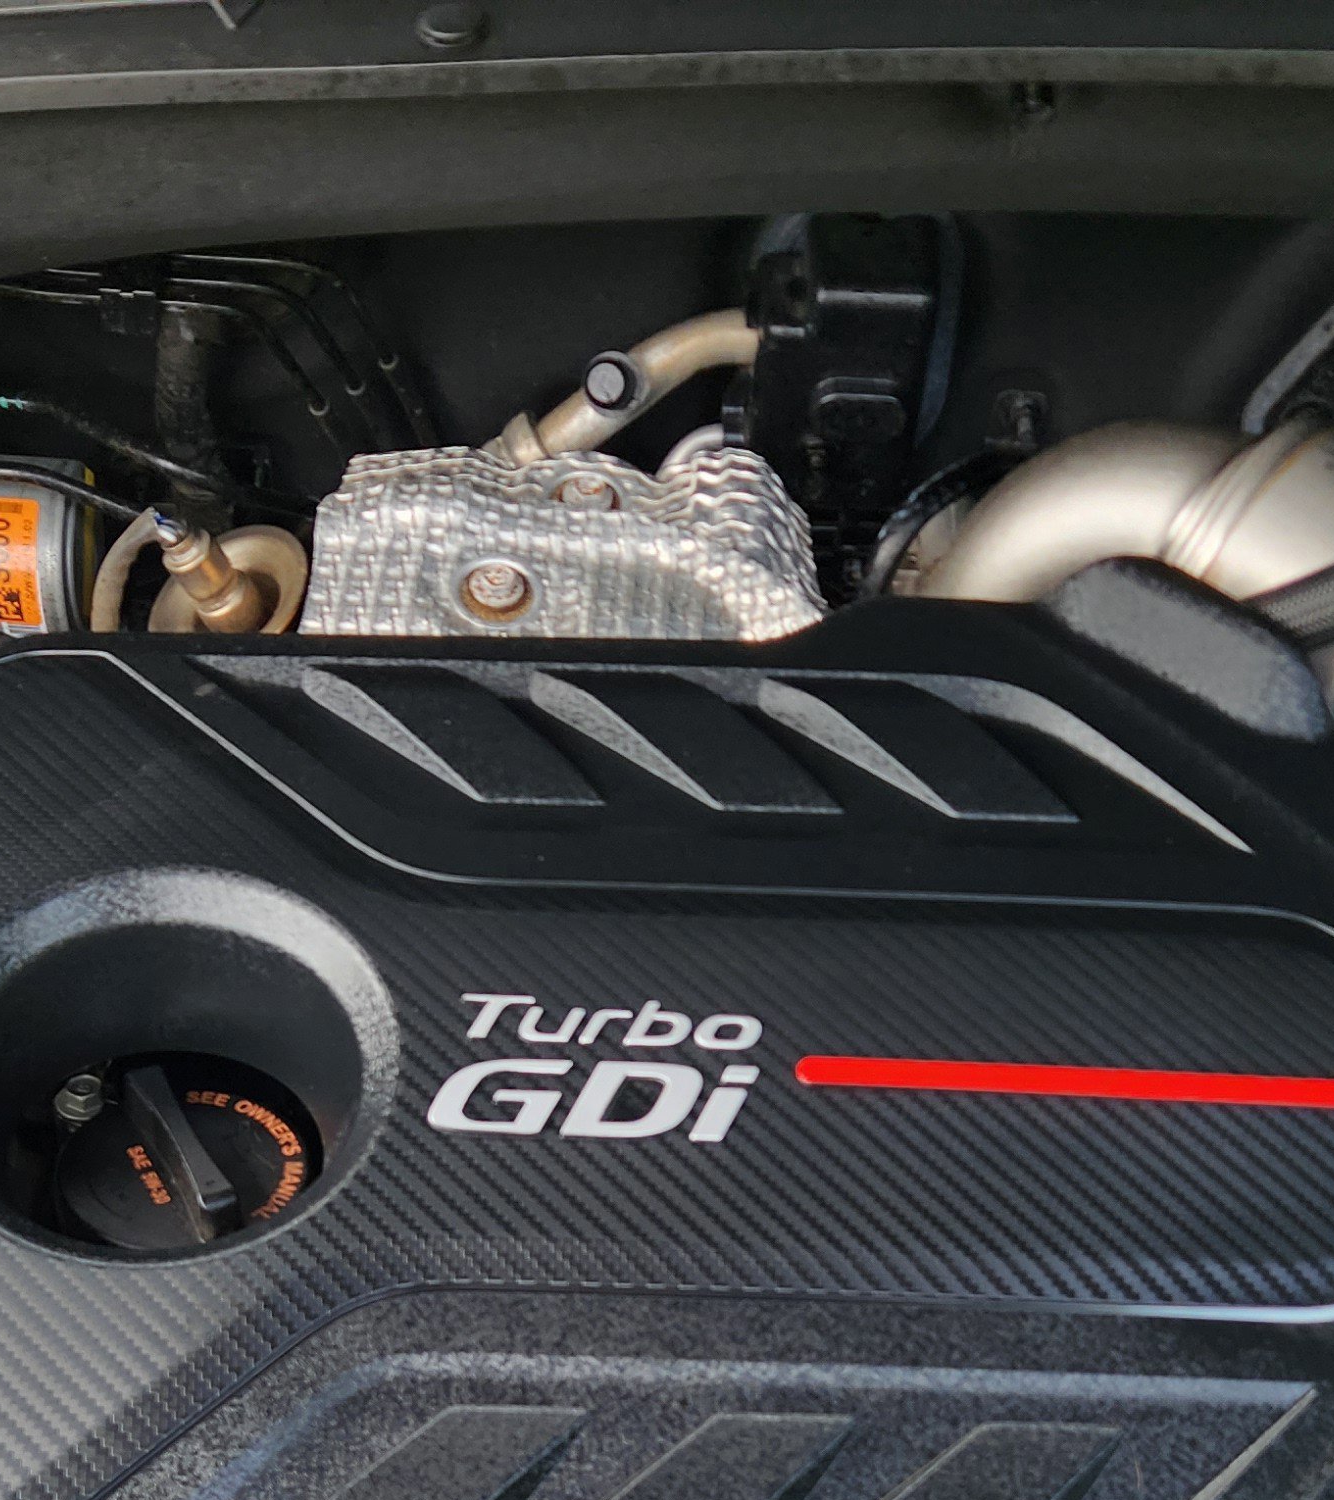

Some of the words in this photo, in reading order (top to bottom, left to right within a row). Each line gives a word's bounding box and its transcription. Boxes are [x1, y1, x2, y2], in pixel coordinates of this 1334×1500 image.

[461, 993, 763, 1050] Turbo
[427, 1058, 761, 1143] GDi
[186, 1090, 230, 1108] SEE
[251, 1161, 304, 1219] MANUAL
